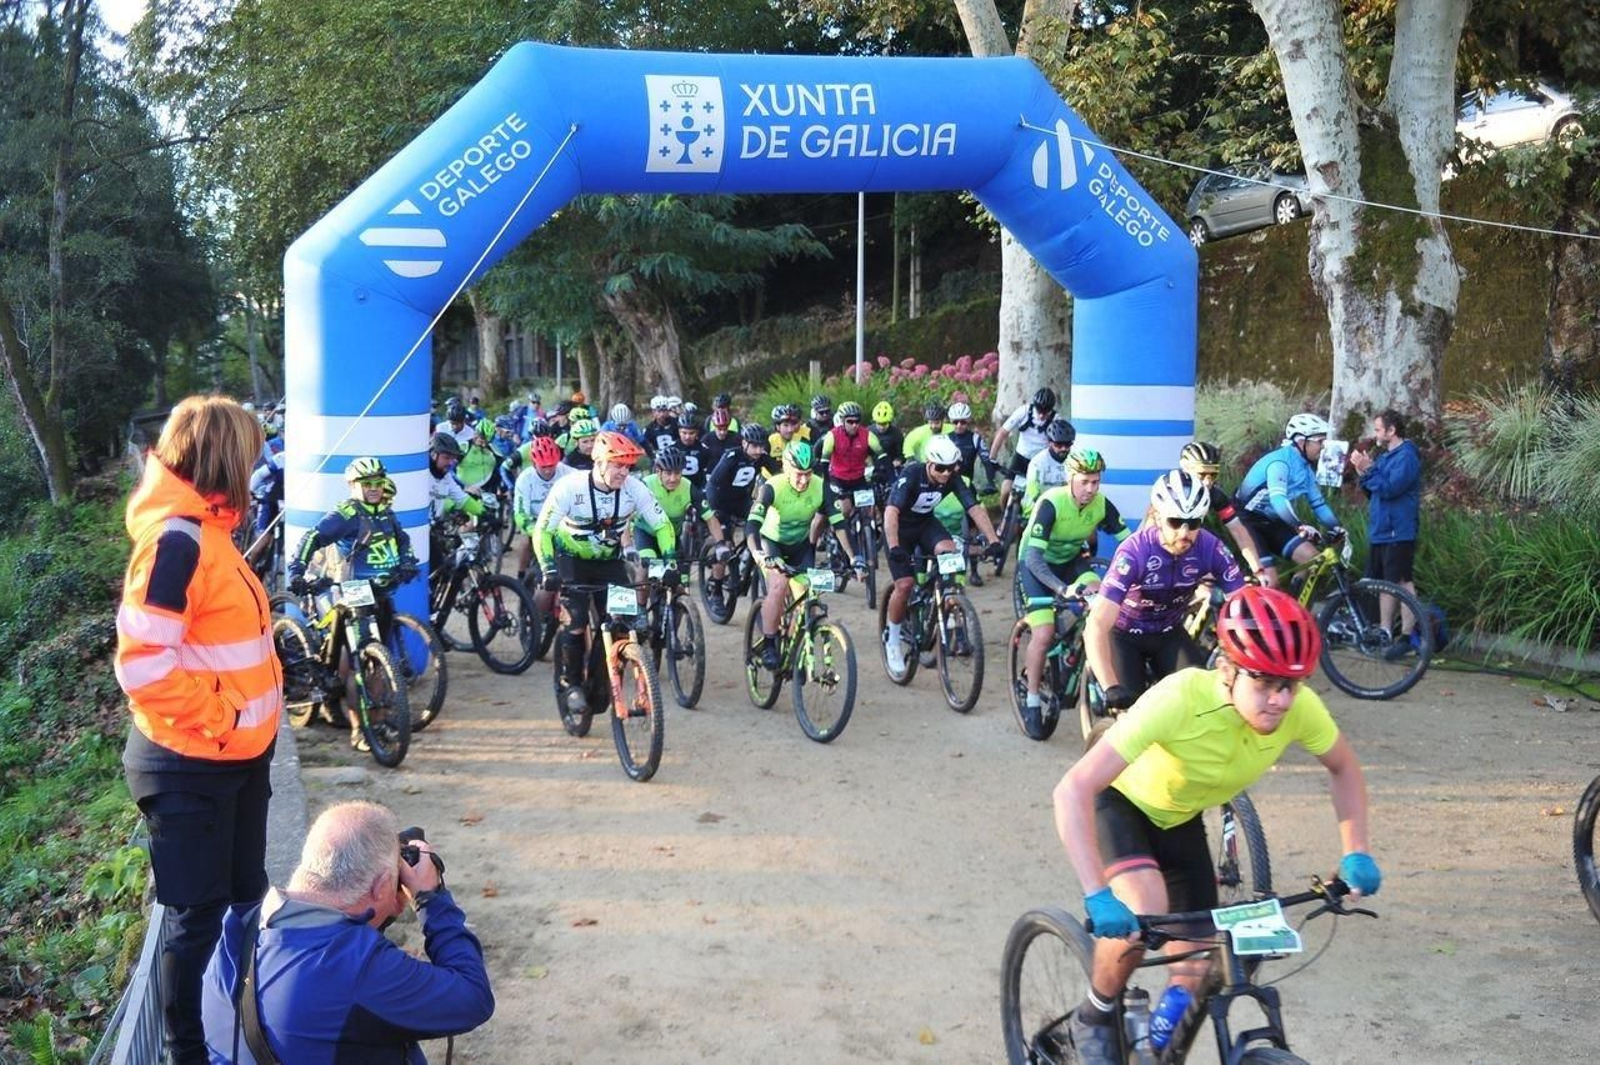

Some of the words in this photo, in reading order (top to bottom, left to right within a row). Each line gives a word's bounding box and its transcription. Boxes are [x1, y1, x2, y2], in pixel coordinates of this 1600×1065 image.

[739, 83, 877, 117] XUNTA
[419, 112, 528, 201] DEPORTE
[739, 125, 791, 160] DE
[800, 123, 957, 158] GALICIA
[438, 140, 532, 217] GALEGO
[1088, 178, 1154, 247] GALEGO
[1098, 162, 1171, 242] DEPORTE
